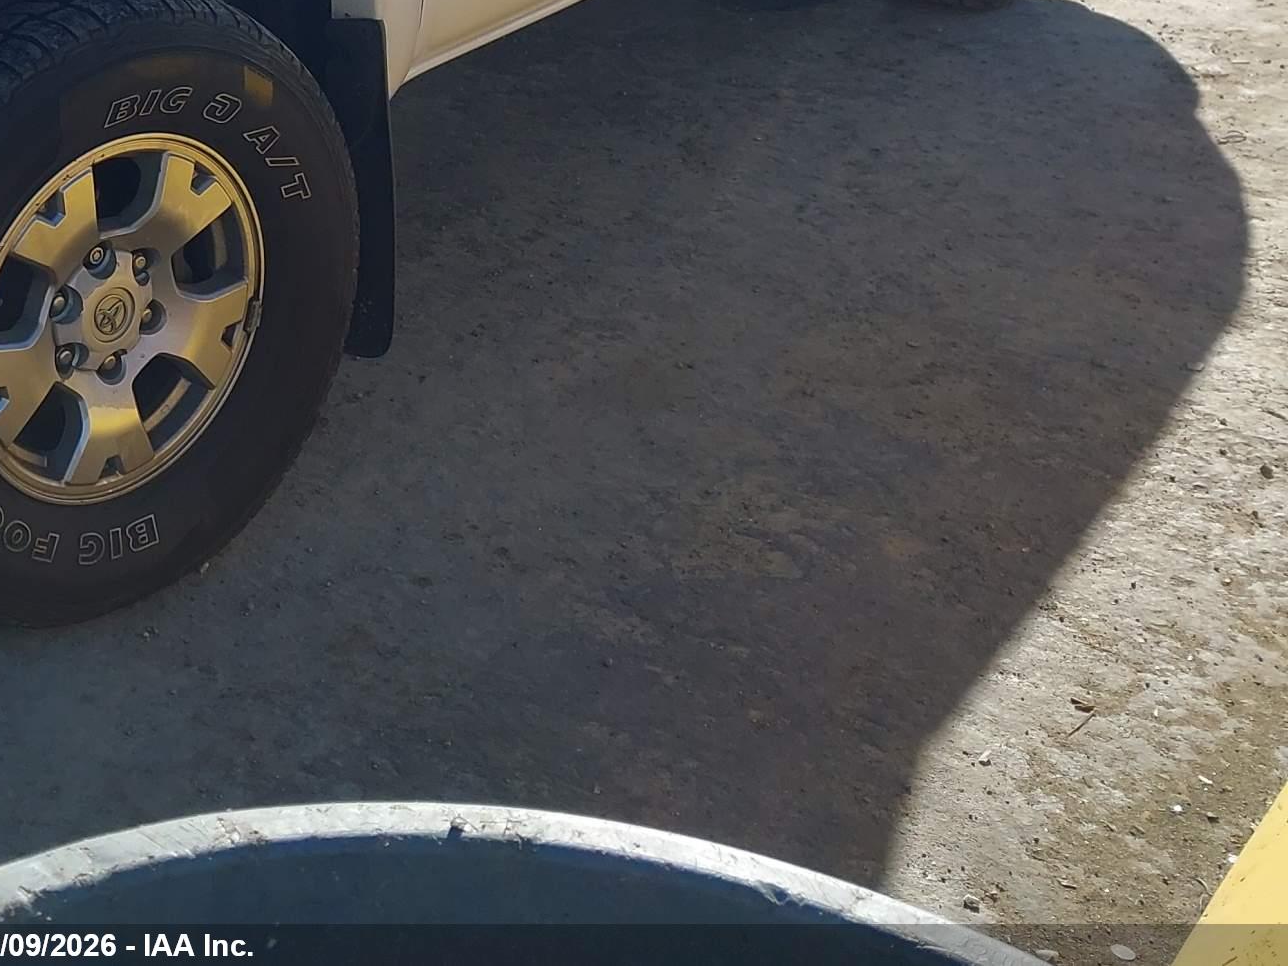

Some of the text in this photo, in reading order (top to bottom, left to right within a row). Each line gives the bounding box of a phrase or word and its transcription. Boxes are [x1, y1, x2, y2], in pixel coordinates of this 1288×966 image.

[103, 86, 194, 129] BIG
[243, 125, 312, 200] A/T
[78, 513, 161, 566] BIG
